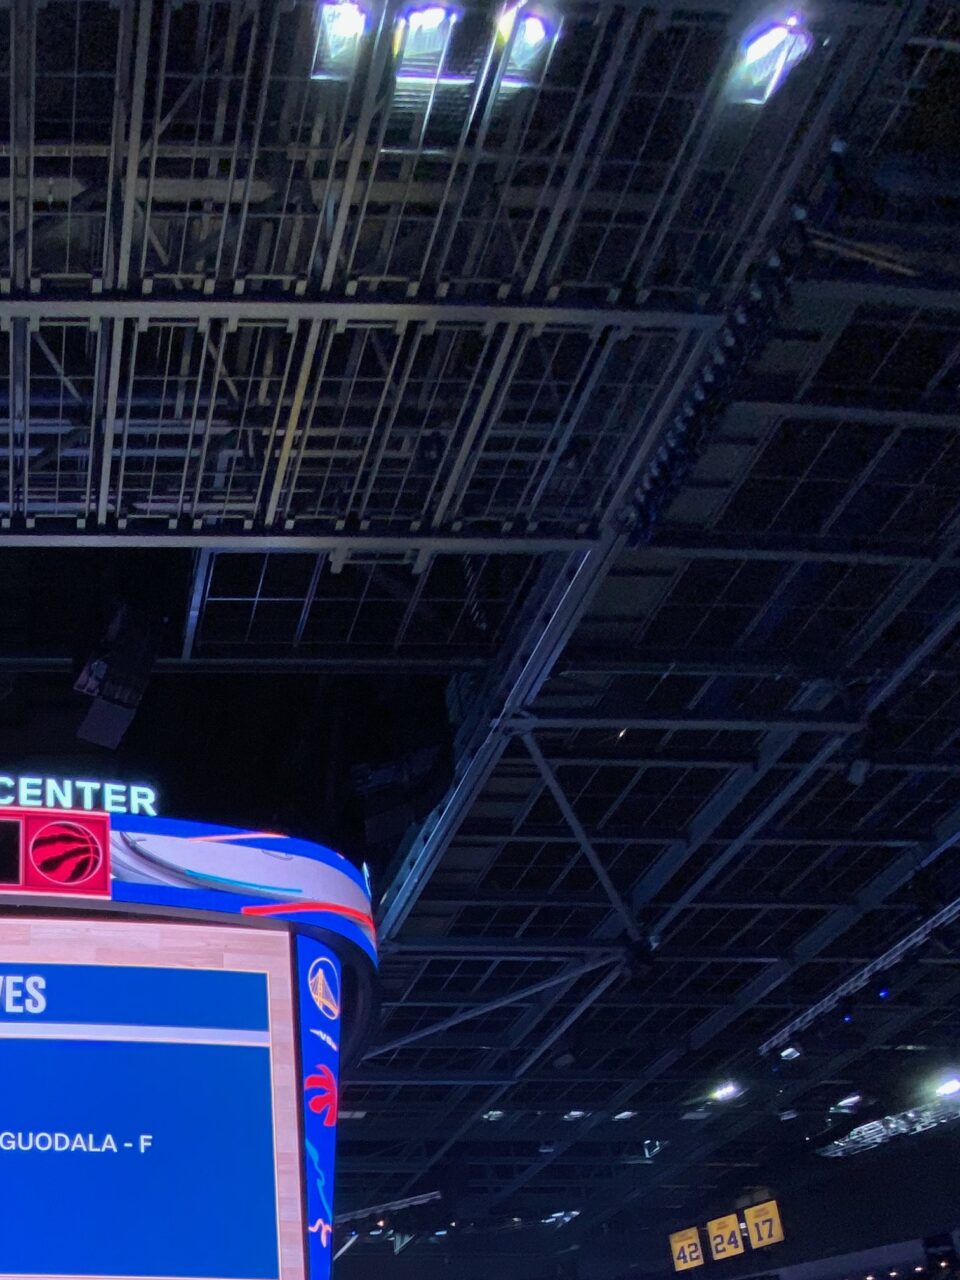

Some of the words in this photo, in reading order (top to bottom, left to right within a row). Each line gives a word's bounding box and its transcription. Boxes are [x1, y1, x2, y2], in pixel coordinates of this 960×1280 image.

[139, 1135, 153, 1153] F
[754, 1218, 773, 1241] 17
[713, 1230, 739, 1253] 24
[677, 1242, 700, 1264] 42
